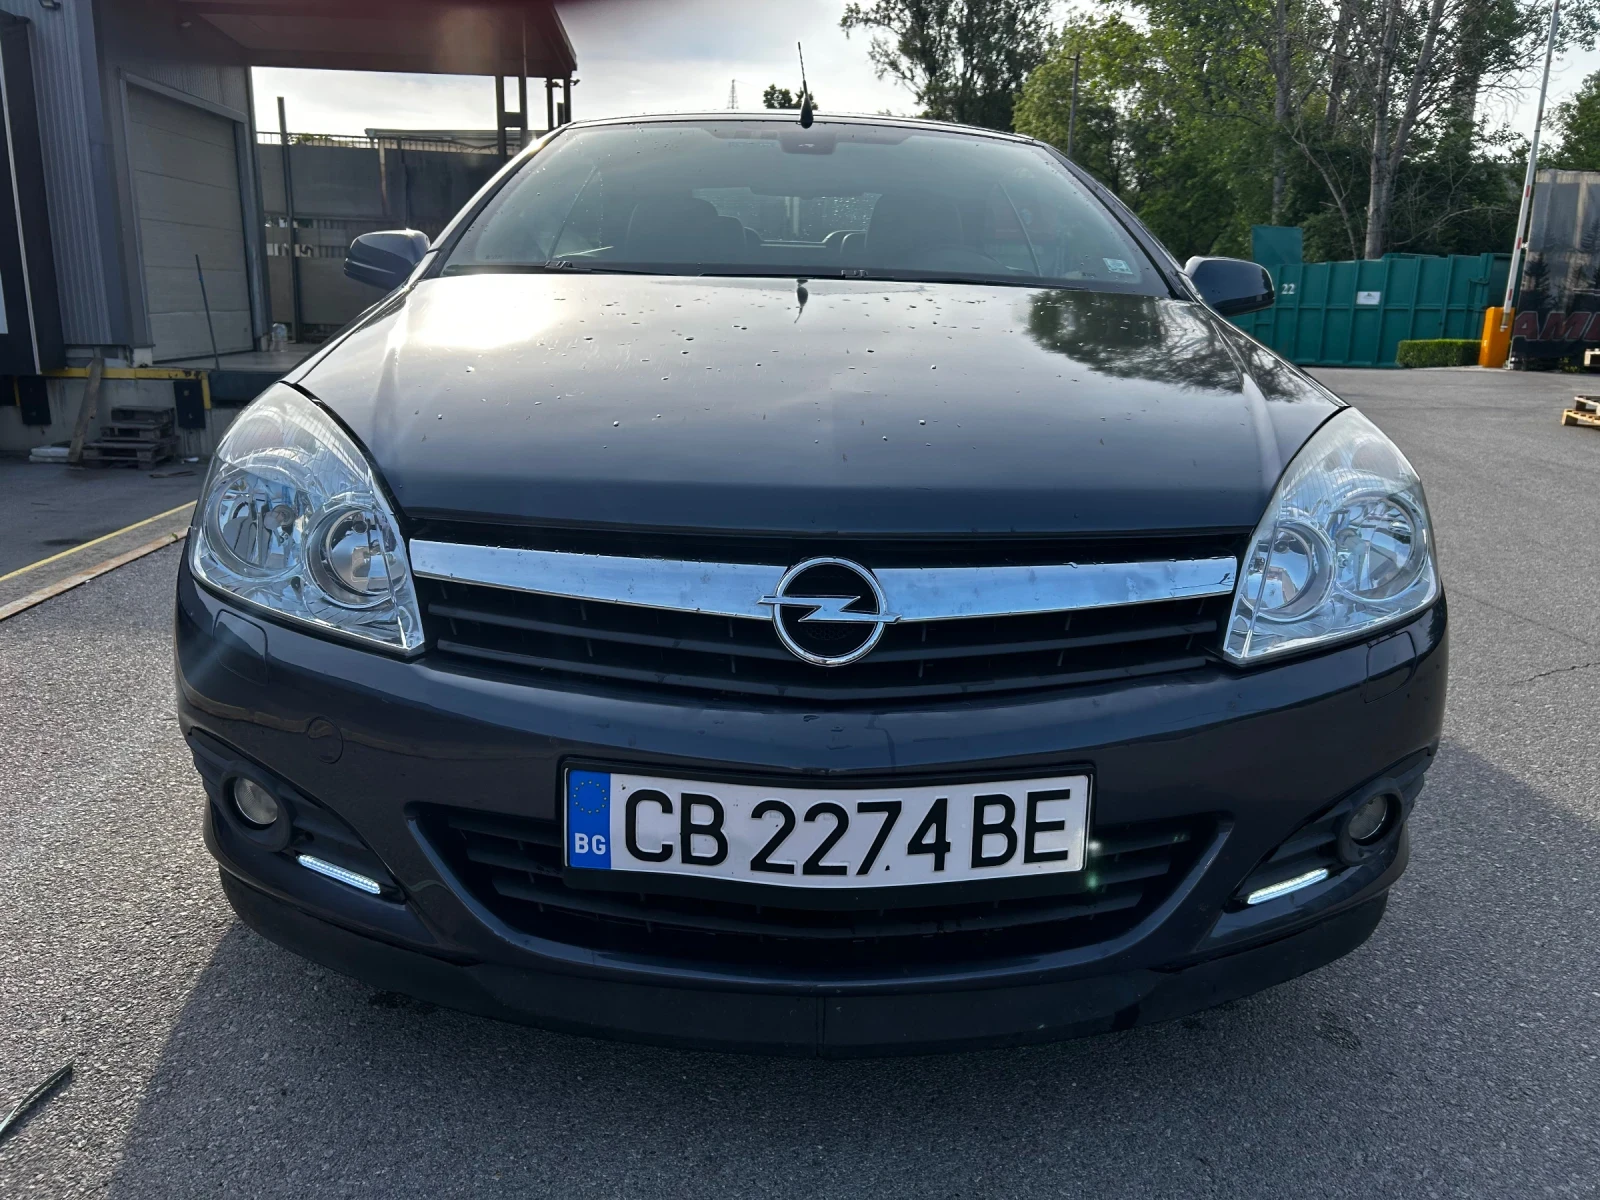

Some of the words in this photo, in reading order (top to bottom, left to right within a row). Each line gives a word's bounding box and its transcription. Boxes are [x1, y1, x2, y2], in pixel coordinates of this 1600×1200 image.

[1281, 283, 1296, 295] 22
[1514, 311, 1600, 342] AM
[574, 832, 606, 855] BG
[625, 788, 729, 866] CB
[750, 797, 951, 876] 2274
[970, 788, 1071, 869] BE
